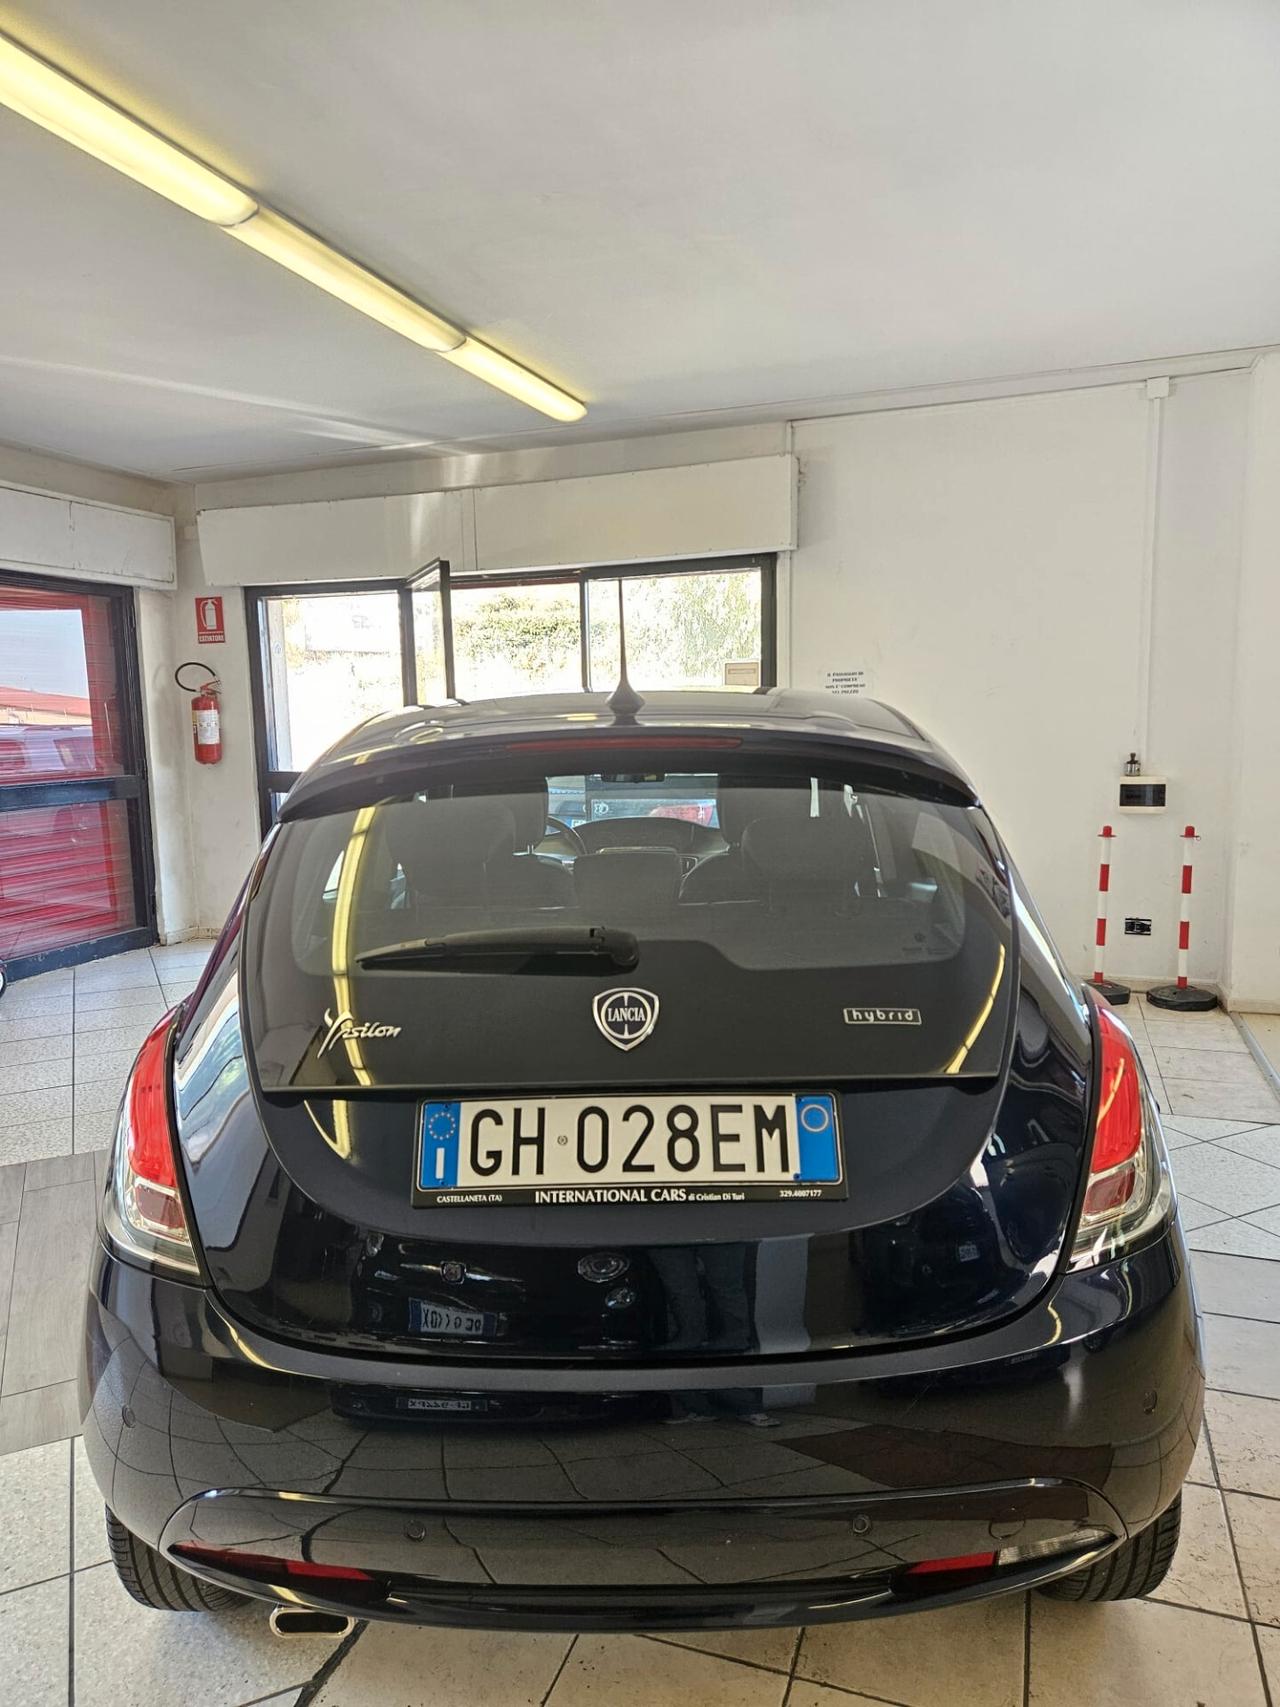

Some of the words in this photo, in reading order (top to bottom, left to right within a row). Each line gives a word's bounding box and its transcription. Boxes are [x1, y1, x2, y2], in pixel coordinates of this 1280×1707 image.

[607, 1007, 646, 1021] LANCIA
[852, 1009, 913, 1023] hybrid
[317, 1008, 402, 1059] Ypsilon
[435, 1147, 445, 1180] I
[470, 1107, 546, 1177] GH
[577, 1104, 789, 1173] 028EM
[437, 1194, 487, 1204] CASTELLANETA
[488, 1194, 503, 1202] (TA)
[535, 1189, 647, 1203] INTERNATIONAL
[650, 1188, 687, 1202] CARS
[722, 1193, 731, 1201] Di
